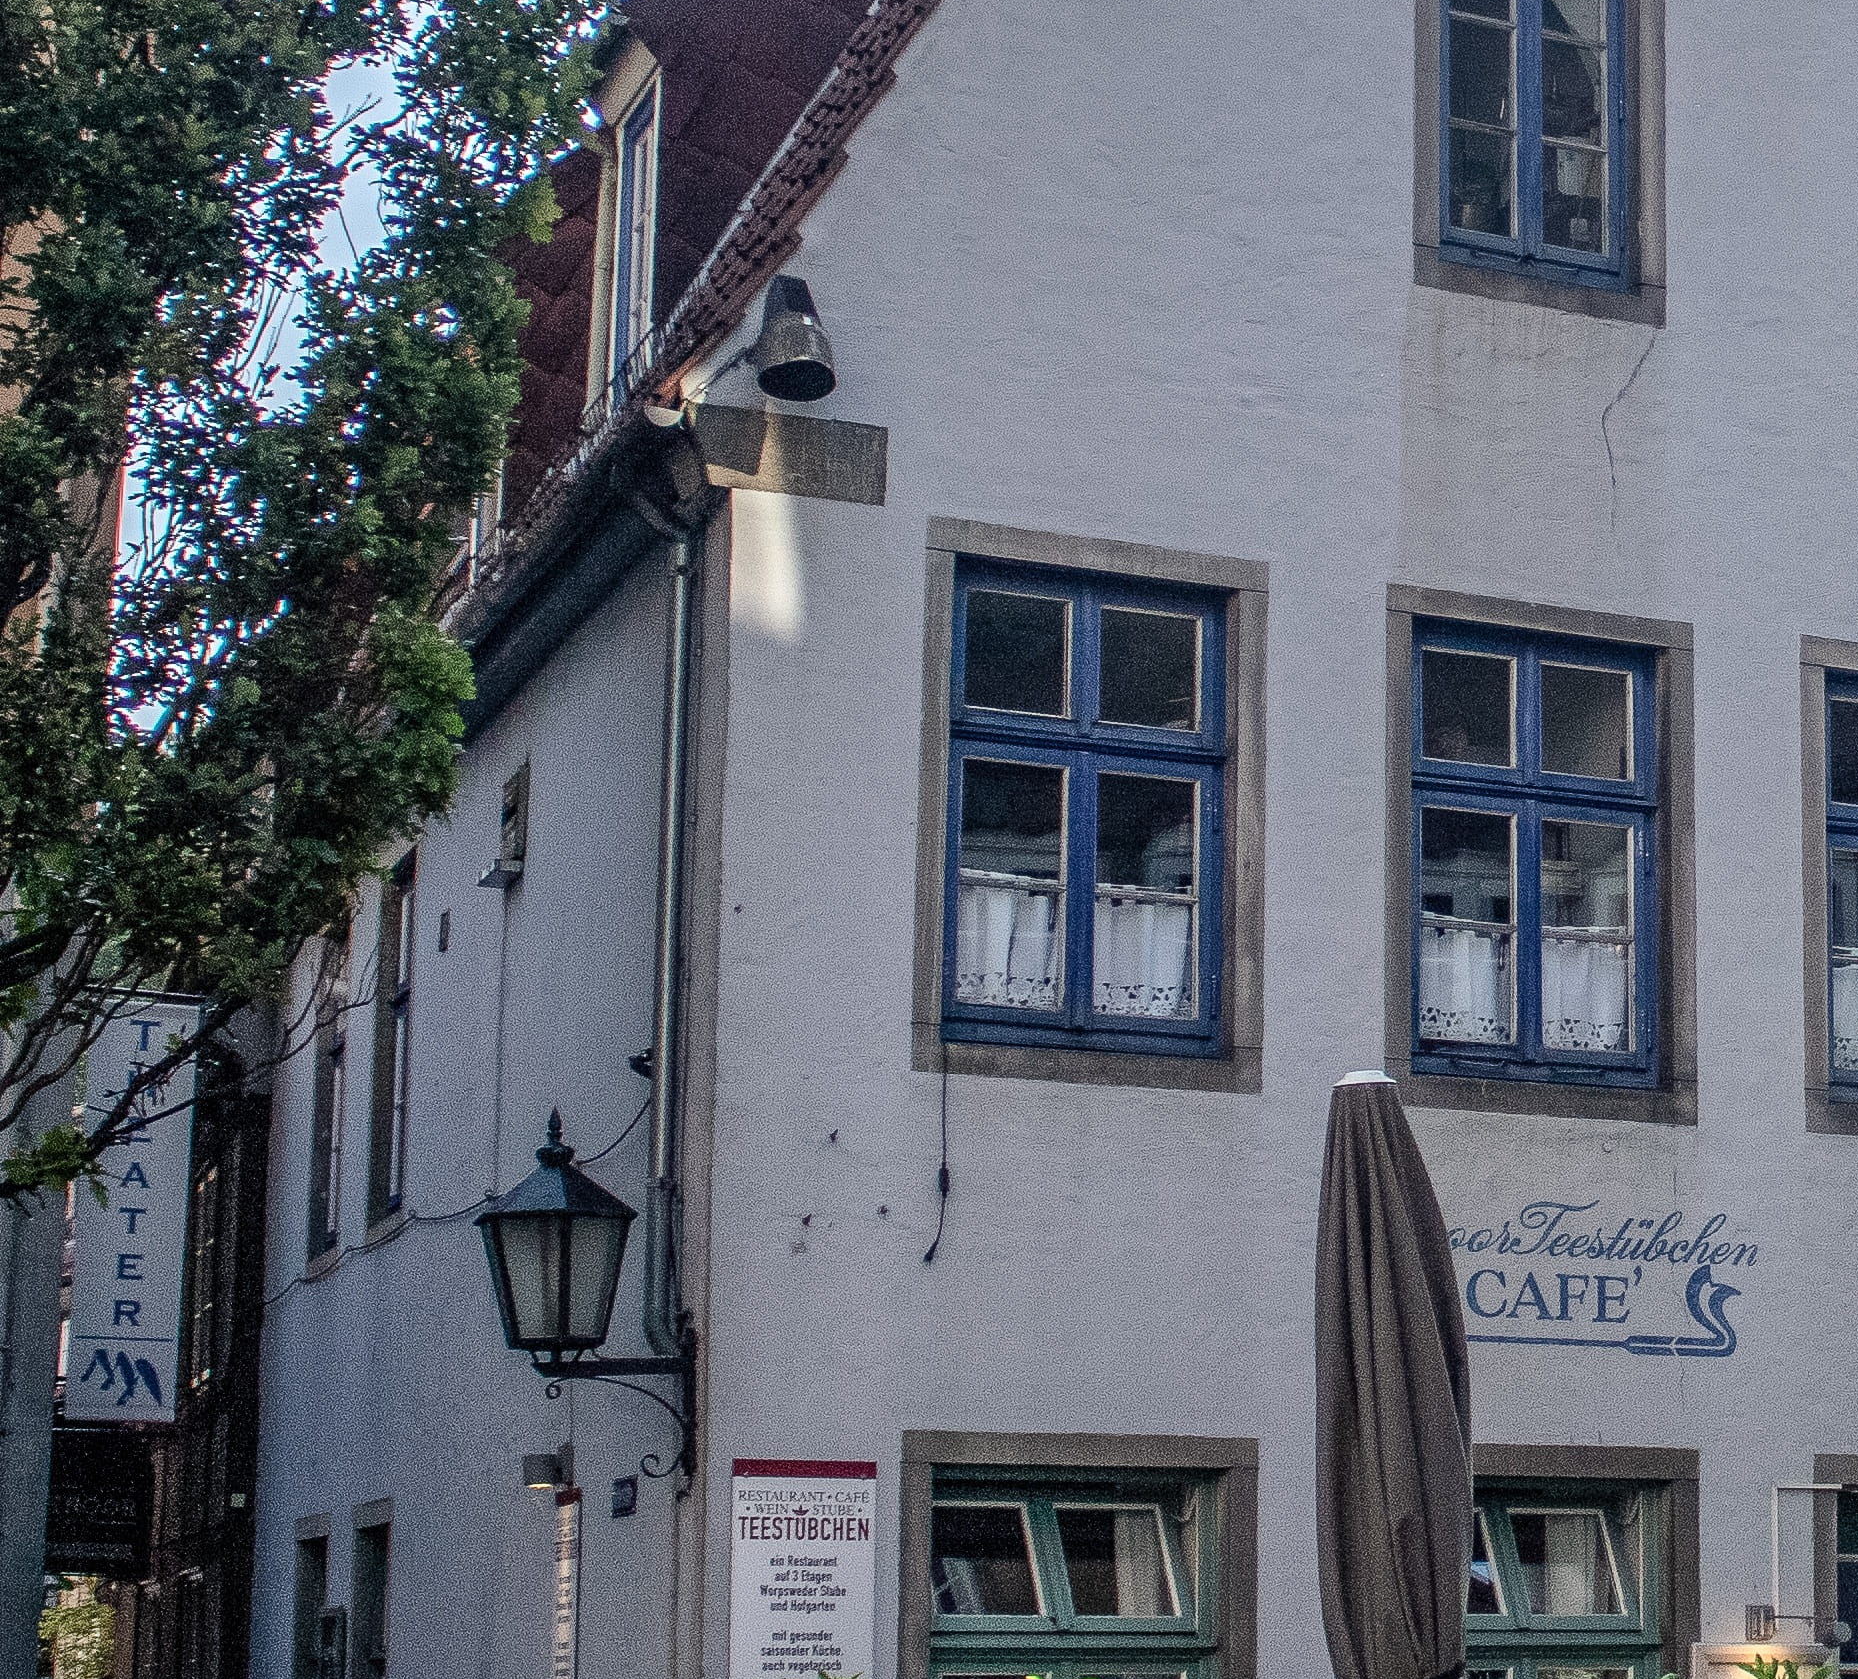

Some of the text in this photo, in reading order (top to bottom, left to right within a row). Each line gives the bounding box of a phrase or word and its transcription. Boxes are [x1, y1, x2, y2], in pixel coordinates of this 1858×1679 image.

[1510, 1200, 1757, 1268] Teestübchen
[738, 1490, 825, 1502] RESTAURANT
[754, 1503, 854, 1516] WEIN STUBE
[787, 1555, 837, 1567] Restaurant
[775, 1570, 833, 1584] auf 3 Etagen
[760, 1585, 818, 1599] Worpsweder
[770, 1600, 836, 1614] und Hofgarten
[772, 1630, 833, 1644] mit gesunder
[761, 1645, 809, 1656] saisonaler
[762, 1659, 842, 1675] auch vegetarisch
